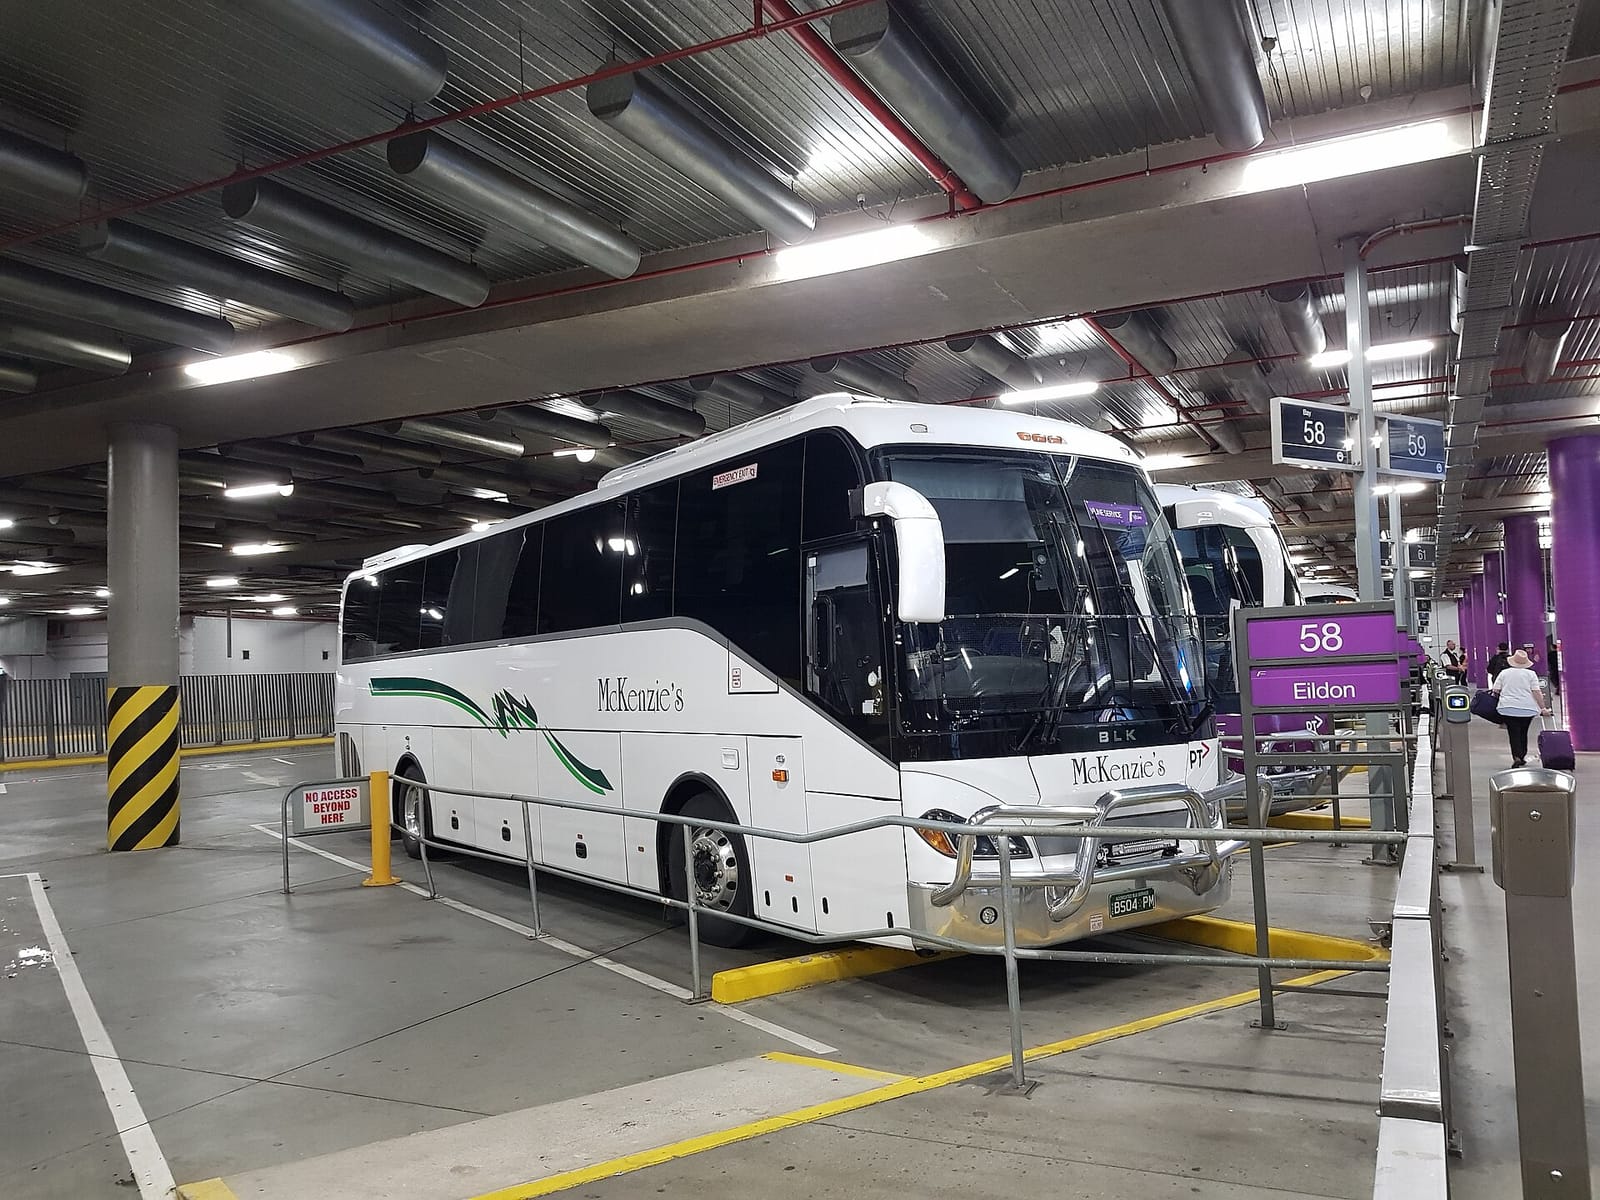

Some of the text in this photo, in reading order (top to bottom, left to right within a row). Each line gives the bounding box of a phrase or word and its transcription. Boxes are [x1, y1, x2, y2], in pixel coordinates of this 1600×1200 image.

[1303, 420, 1326, 445] 58
[1408, 434, 1427, 457] 59
[1299, 622, 1343, 652] 58
[597, 677, 684, 712] McKenzie's
[1293, 682, 1356, 700] Eildon
[1098, 729, 1137, 743] BLK
[1071, 751, 1166, 785] McKenzie's
[1189, 749, 1203, 769] PT
[305, 789, 358, 802] NO ACCESS
[313, 801, 350, 813] BEYOND
[321, 813, 344, 824] HERE
